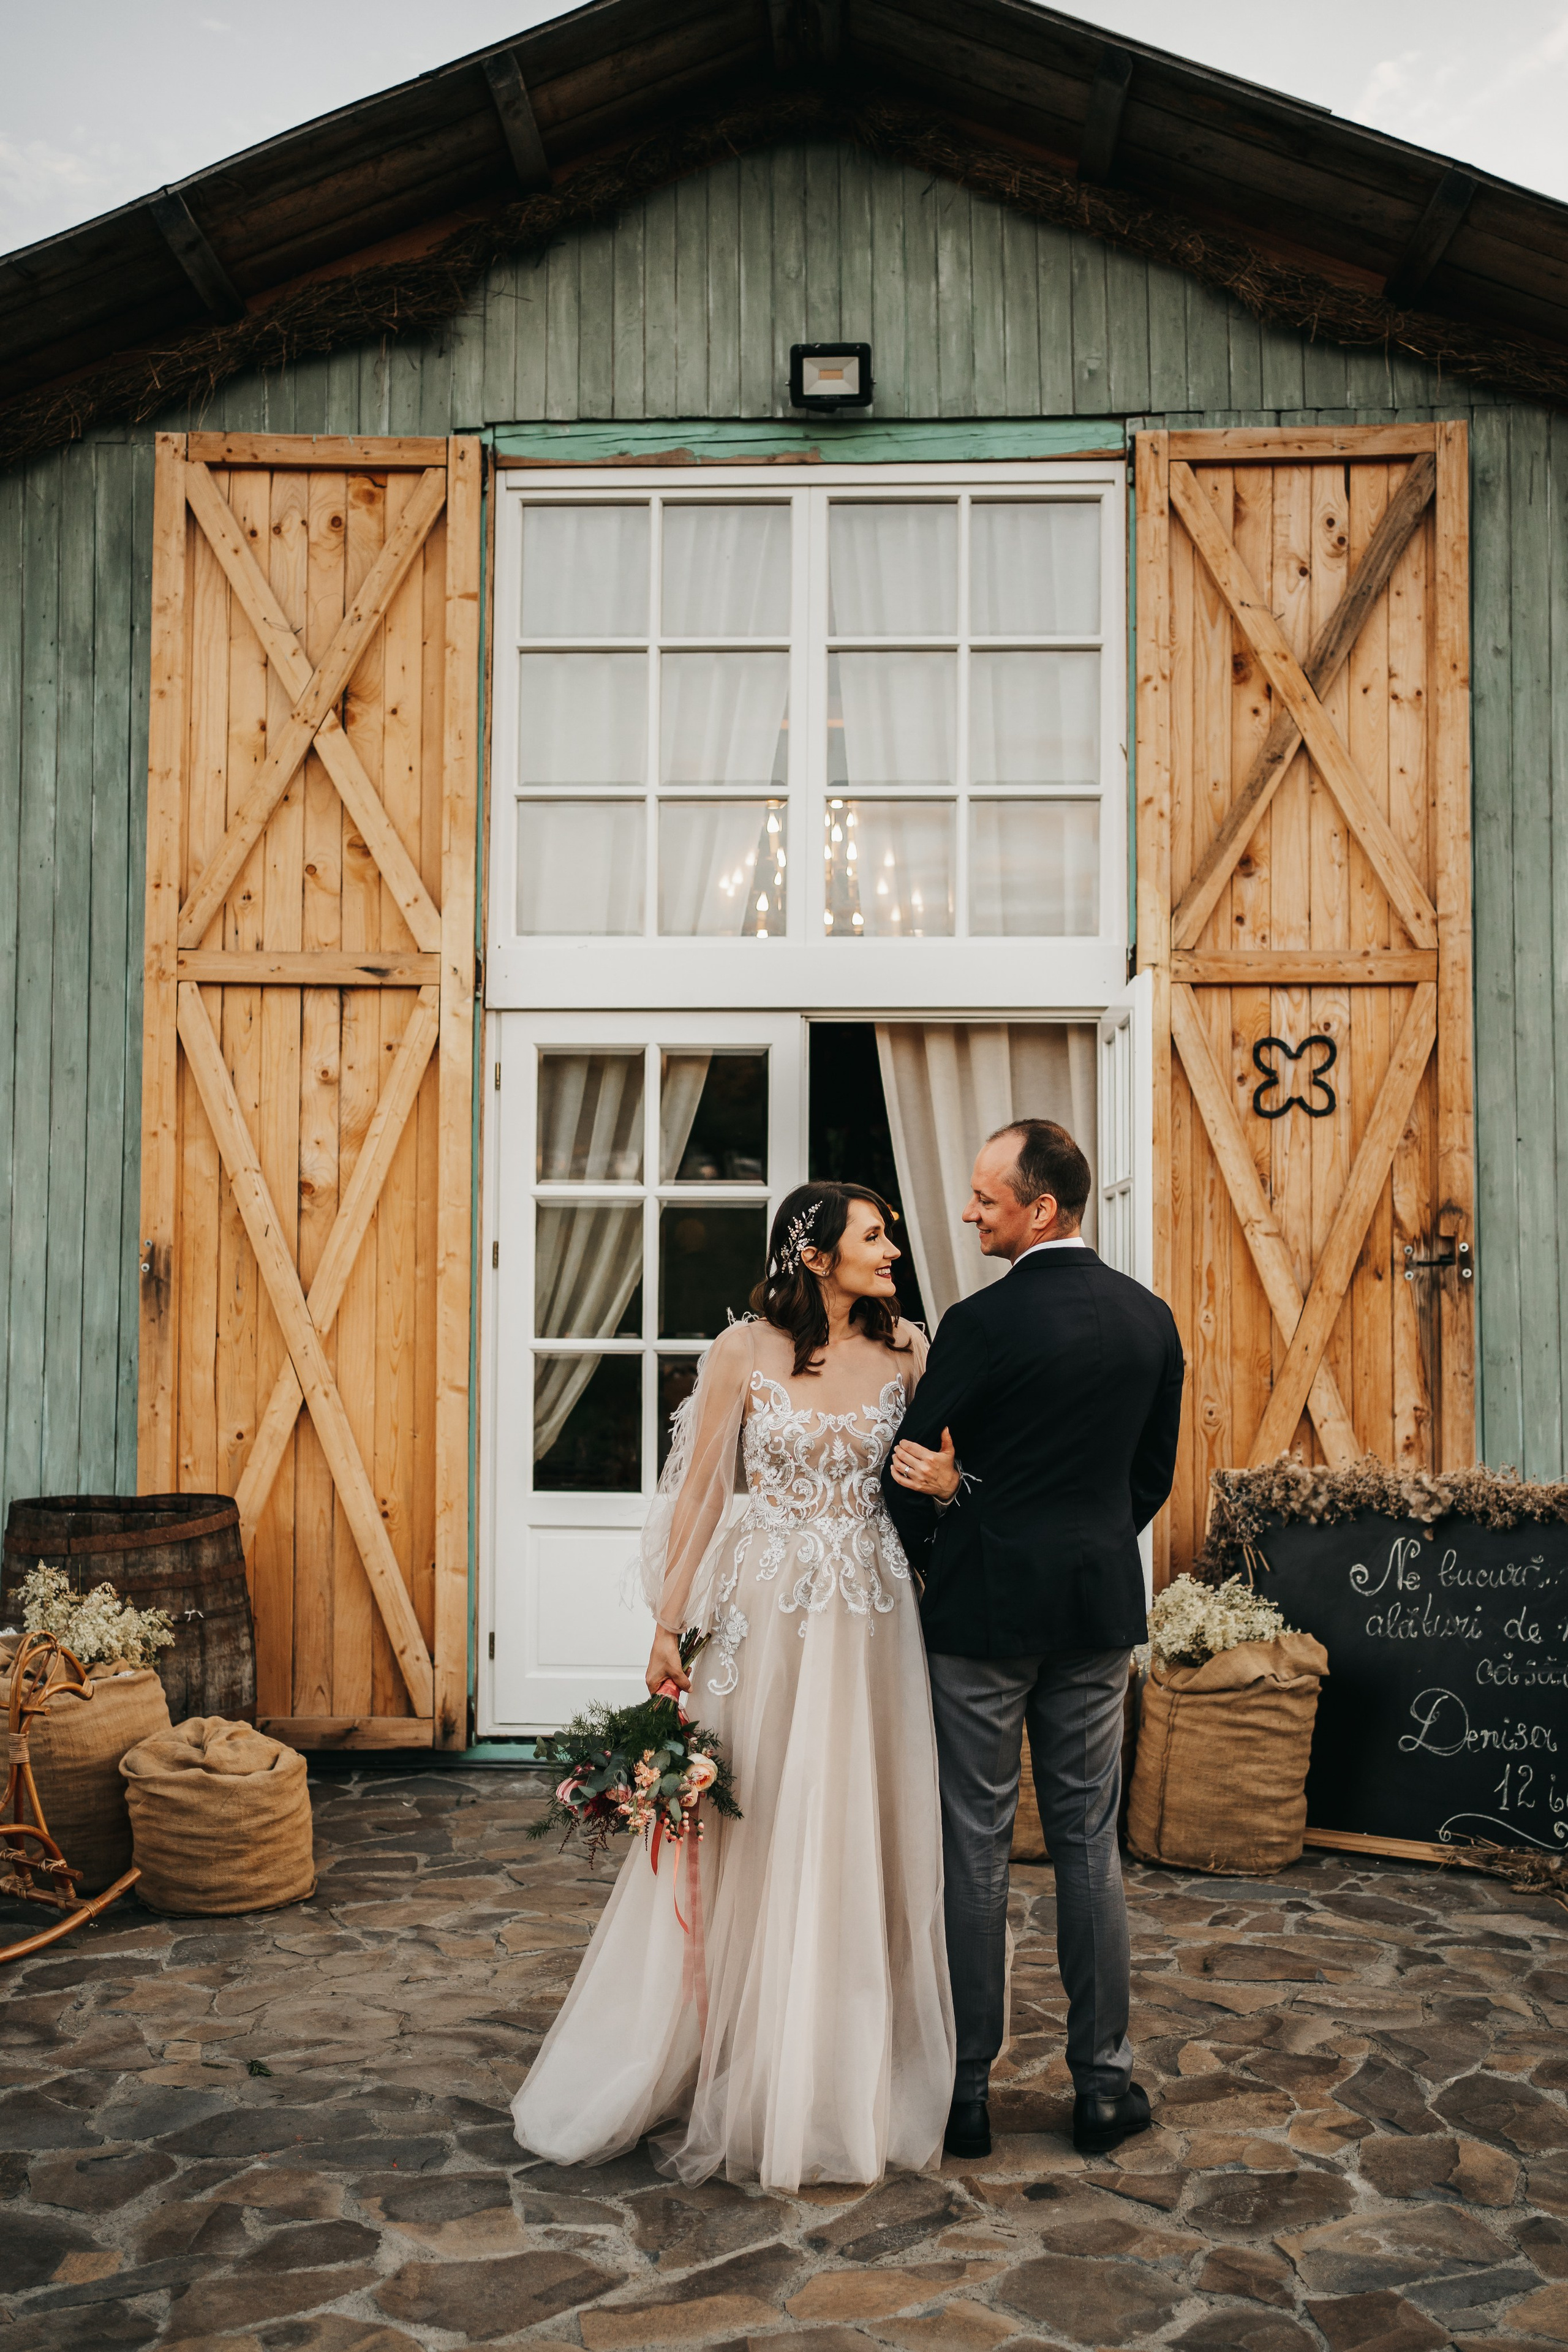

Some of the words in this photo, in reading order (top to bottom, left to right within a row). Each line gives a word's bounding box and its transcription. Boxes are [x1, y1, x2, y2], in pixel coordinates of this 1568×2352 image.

[1349, 1537, 1421, 1597] Ne
[1503, 1605, 1544, 1645] de
[1398, 1687, 1558, 1757] Denisa
[1493, 1763, 1536, 1811] 12
